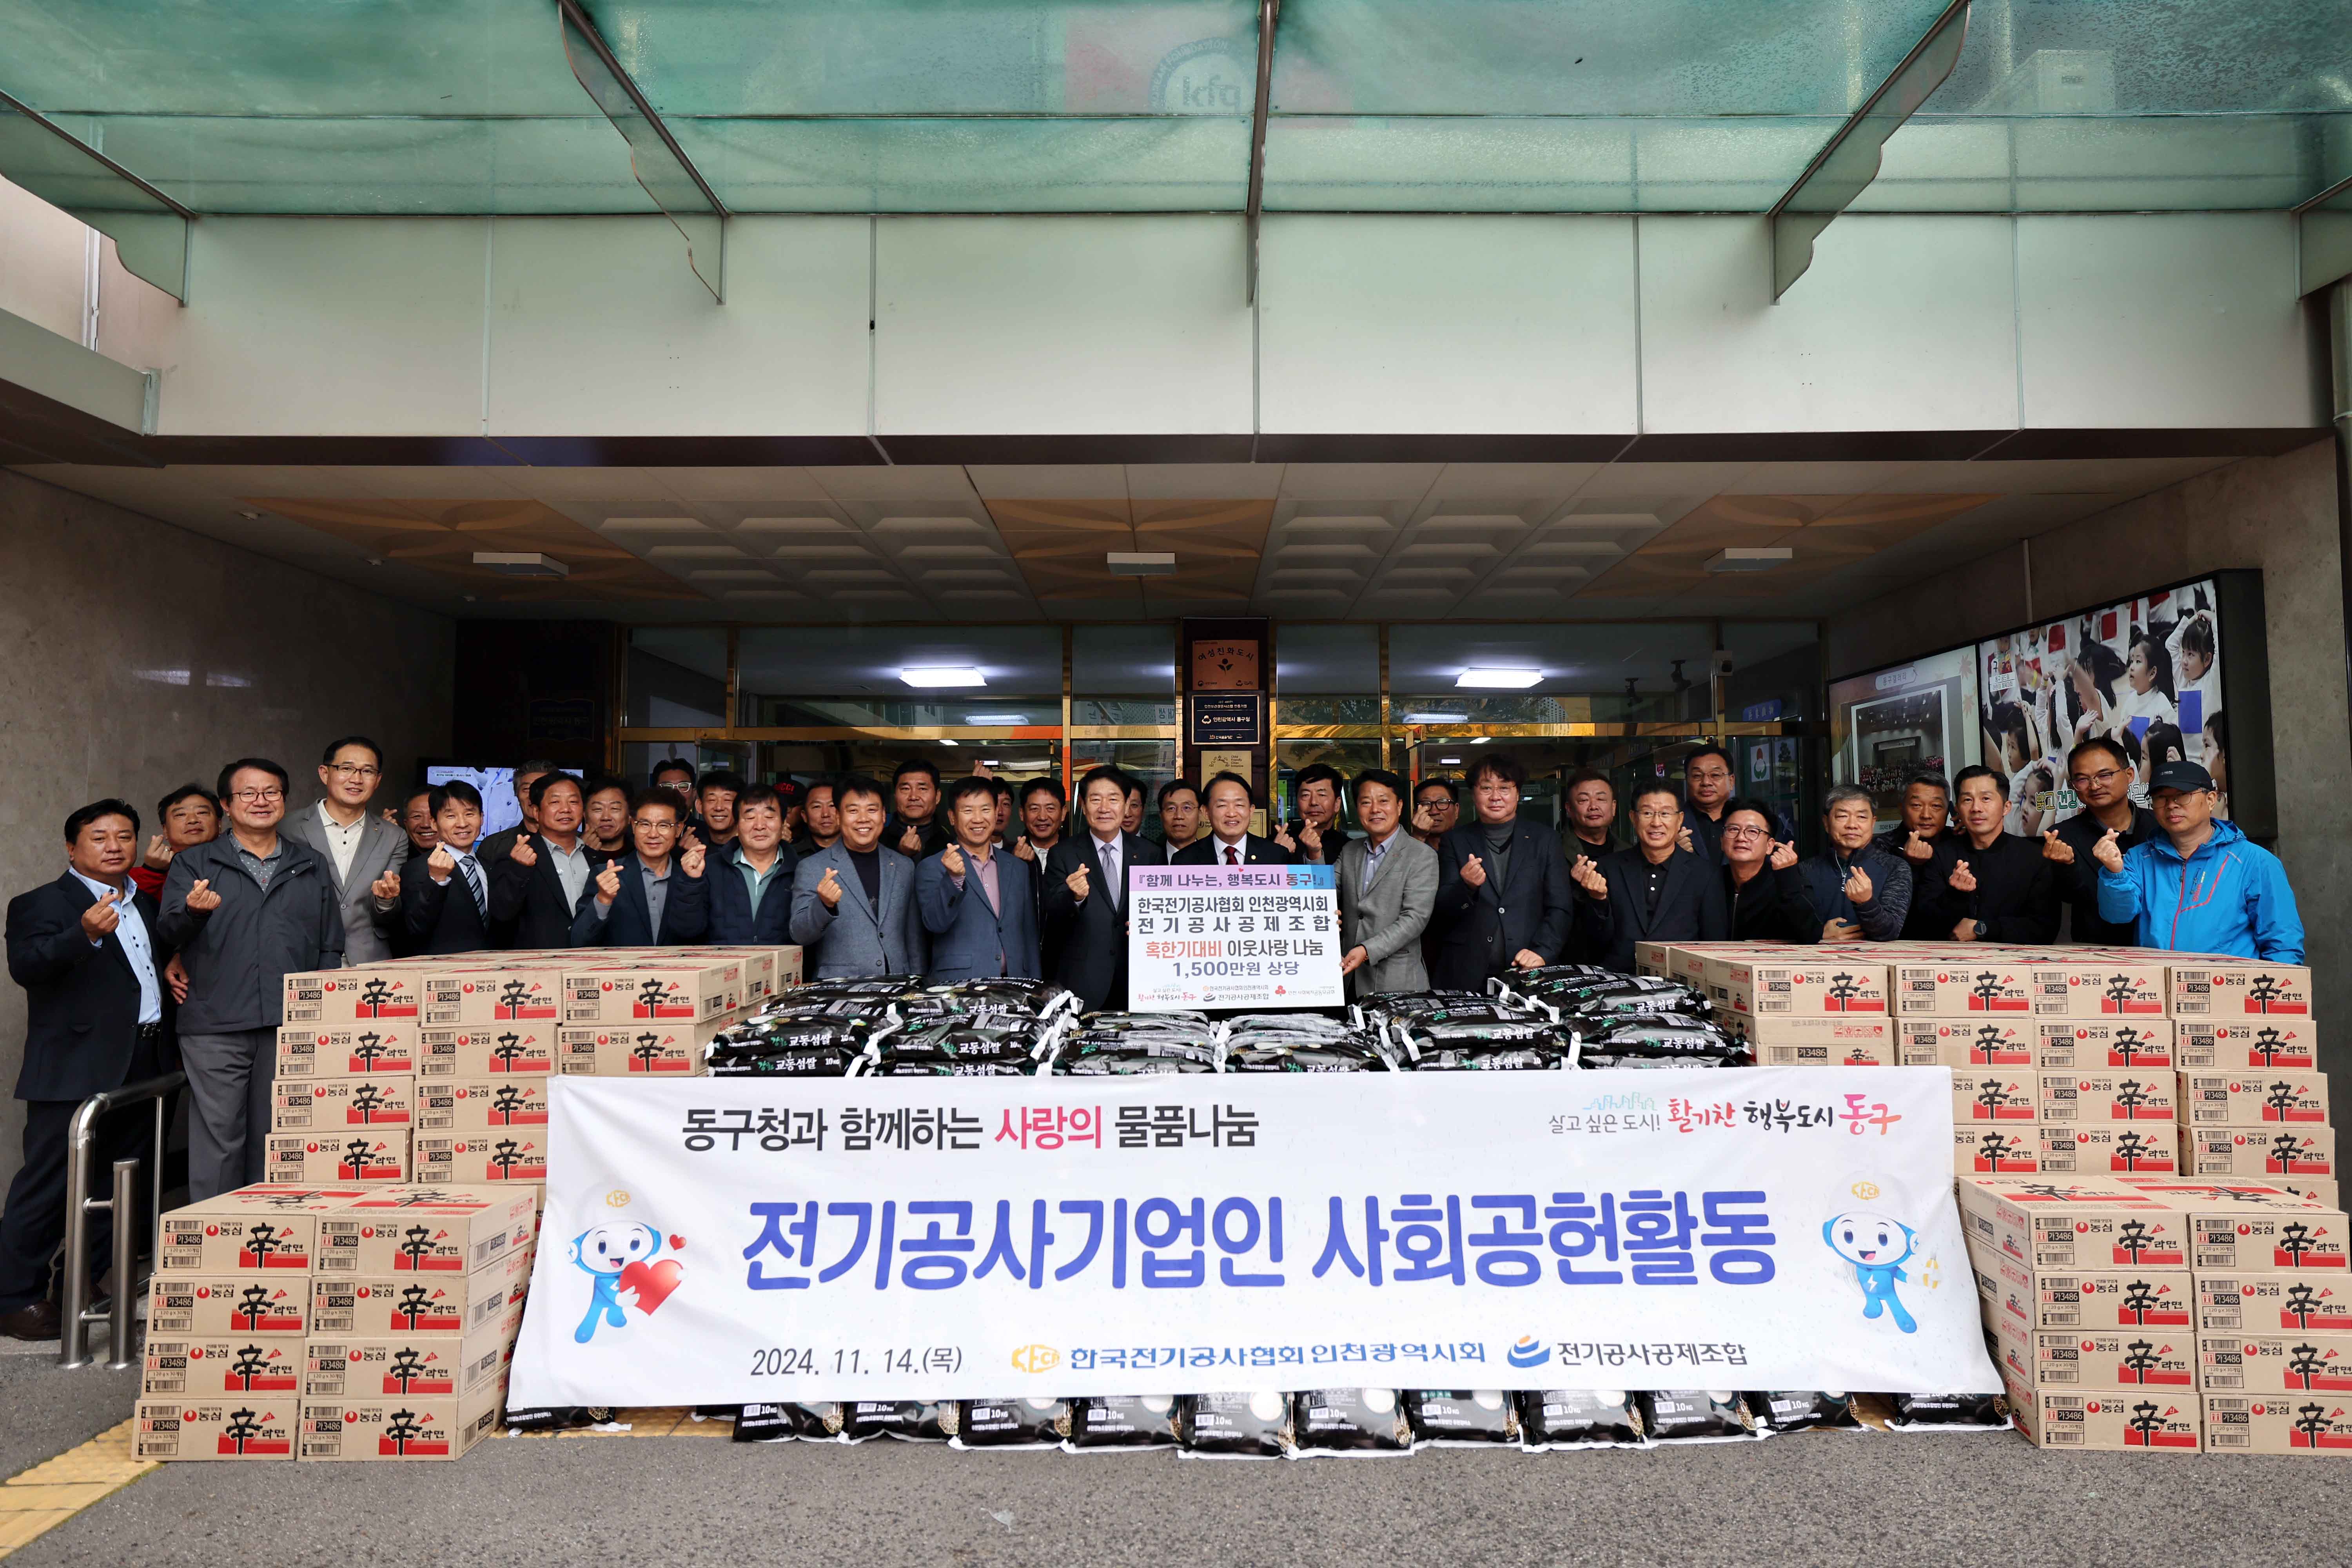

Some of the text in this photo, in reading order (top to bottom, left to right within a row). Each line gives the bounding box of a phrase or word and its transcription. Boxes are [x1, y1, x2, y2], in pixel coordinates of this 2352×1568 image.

[1198, 647, 1254, 661] 여성친화도시
[2035, 790, 2056, 811] 밝고
[1178, 874, 1223, 887] 나누는,
[1227, 873, 1280, 886] 행복도시
[1138, 896, 1328, 914] 한국전기공사협회 인천광역시회
[1146, 940, 1323, 958] 혹한기대비 이웃사랑 나눔
[1172, 962, 1299, 978] 1,500만원 상당
[1181, 992, 1197, 1001] 동구
[1975, 971, 2025, 1011] 辛 라면
[2250, 974, 2303, 1014] 辛 라면
[362, 978, 414, 1018] 辛 라면
[639, 978, 690, 1018] 辛 라면
[1636, 999, 1676, 1012] 교동섬쌀
[789, 1034, 832, 1046] 교동섬쌀
[1492, 1027, 1535, 1040] 교동섬쌀
[958, 1042, 1002, 1054] 교동섬쌀
[1662, 1037, 1706, 1050] 교동섬쌀
[1798, 1048, 1826, 1057] 가3486
[775, 1057, 817, 1071] 교동섬쌀
[955, 1064, 997, 1076] 교동섬쌀
[1481, 1057, 1524, 1070] 교동섬쌀
[1549, 1094, 1901, 1135] 살고 싶은 도시! 활기찬 행복도시 동구
[682, 1105, 1259, 1151] 동구청과 함께하는 사랑의 물품나눔
[493, 1139, 545, 1179] 辛 라면
[2272, 1134, 2325, 1174] 辛 라면
[220, 1227, 241, 1235] 농심
[2090, 1223, 2112, 1232] 농심
[178, 1235, 201, 1243] 가3486
[742, 1190, 1776, 1290] 전기공사기업인 사회공헌활동
[2049, 1232, 2072, 1240] 가3486
[2119, 1220, 2178, 1265] 辛 라면
[247, 1223, 304, 1268] 辛 라면
[372, 1289, 394, 1297] 농심
[2096, 1284, 2118, 1292] 농심
[329, 1297, 353, 1305] 가3486
[2054, 1292, 2078, 1301] 가3486
[2124, 1279, 2183, 1325] 辛 라면
[399, 1284, 457, 1330] 辛 라면
[1071, 1342, 1485, 1369] 한국전기공사협회 인천광역시회
[1557, 1343, 1747, 1366] 전기공사공제조합
[751, 1347, 962, 1376] 2024. 11. 14.(목)
[760, 1405, 777, 1414] 10KG
[877, 1403, 894, 1412] 10KG
[1675, 1403, 1693, 1411] 10KG
[1791, 1400, 1810, 1410] 10KG
[2102, 1404, 2123, 1413] 농심
[991, 1408, 1008, 1418] 10KG
[1330, 1408, 1347, 1418] 10KG
[2059, 1412, 2082, 1420] 가3486
[1214, 1416, 1232, 1425] 10KG
[2131, 1401, 2191, 1446] 辛 라면
